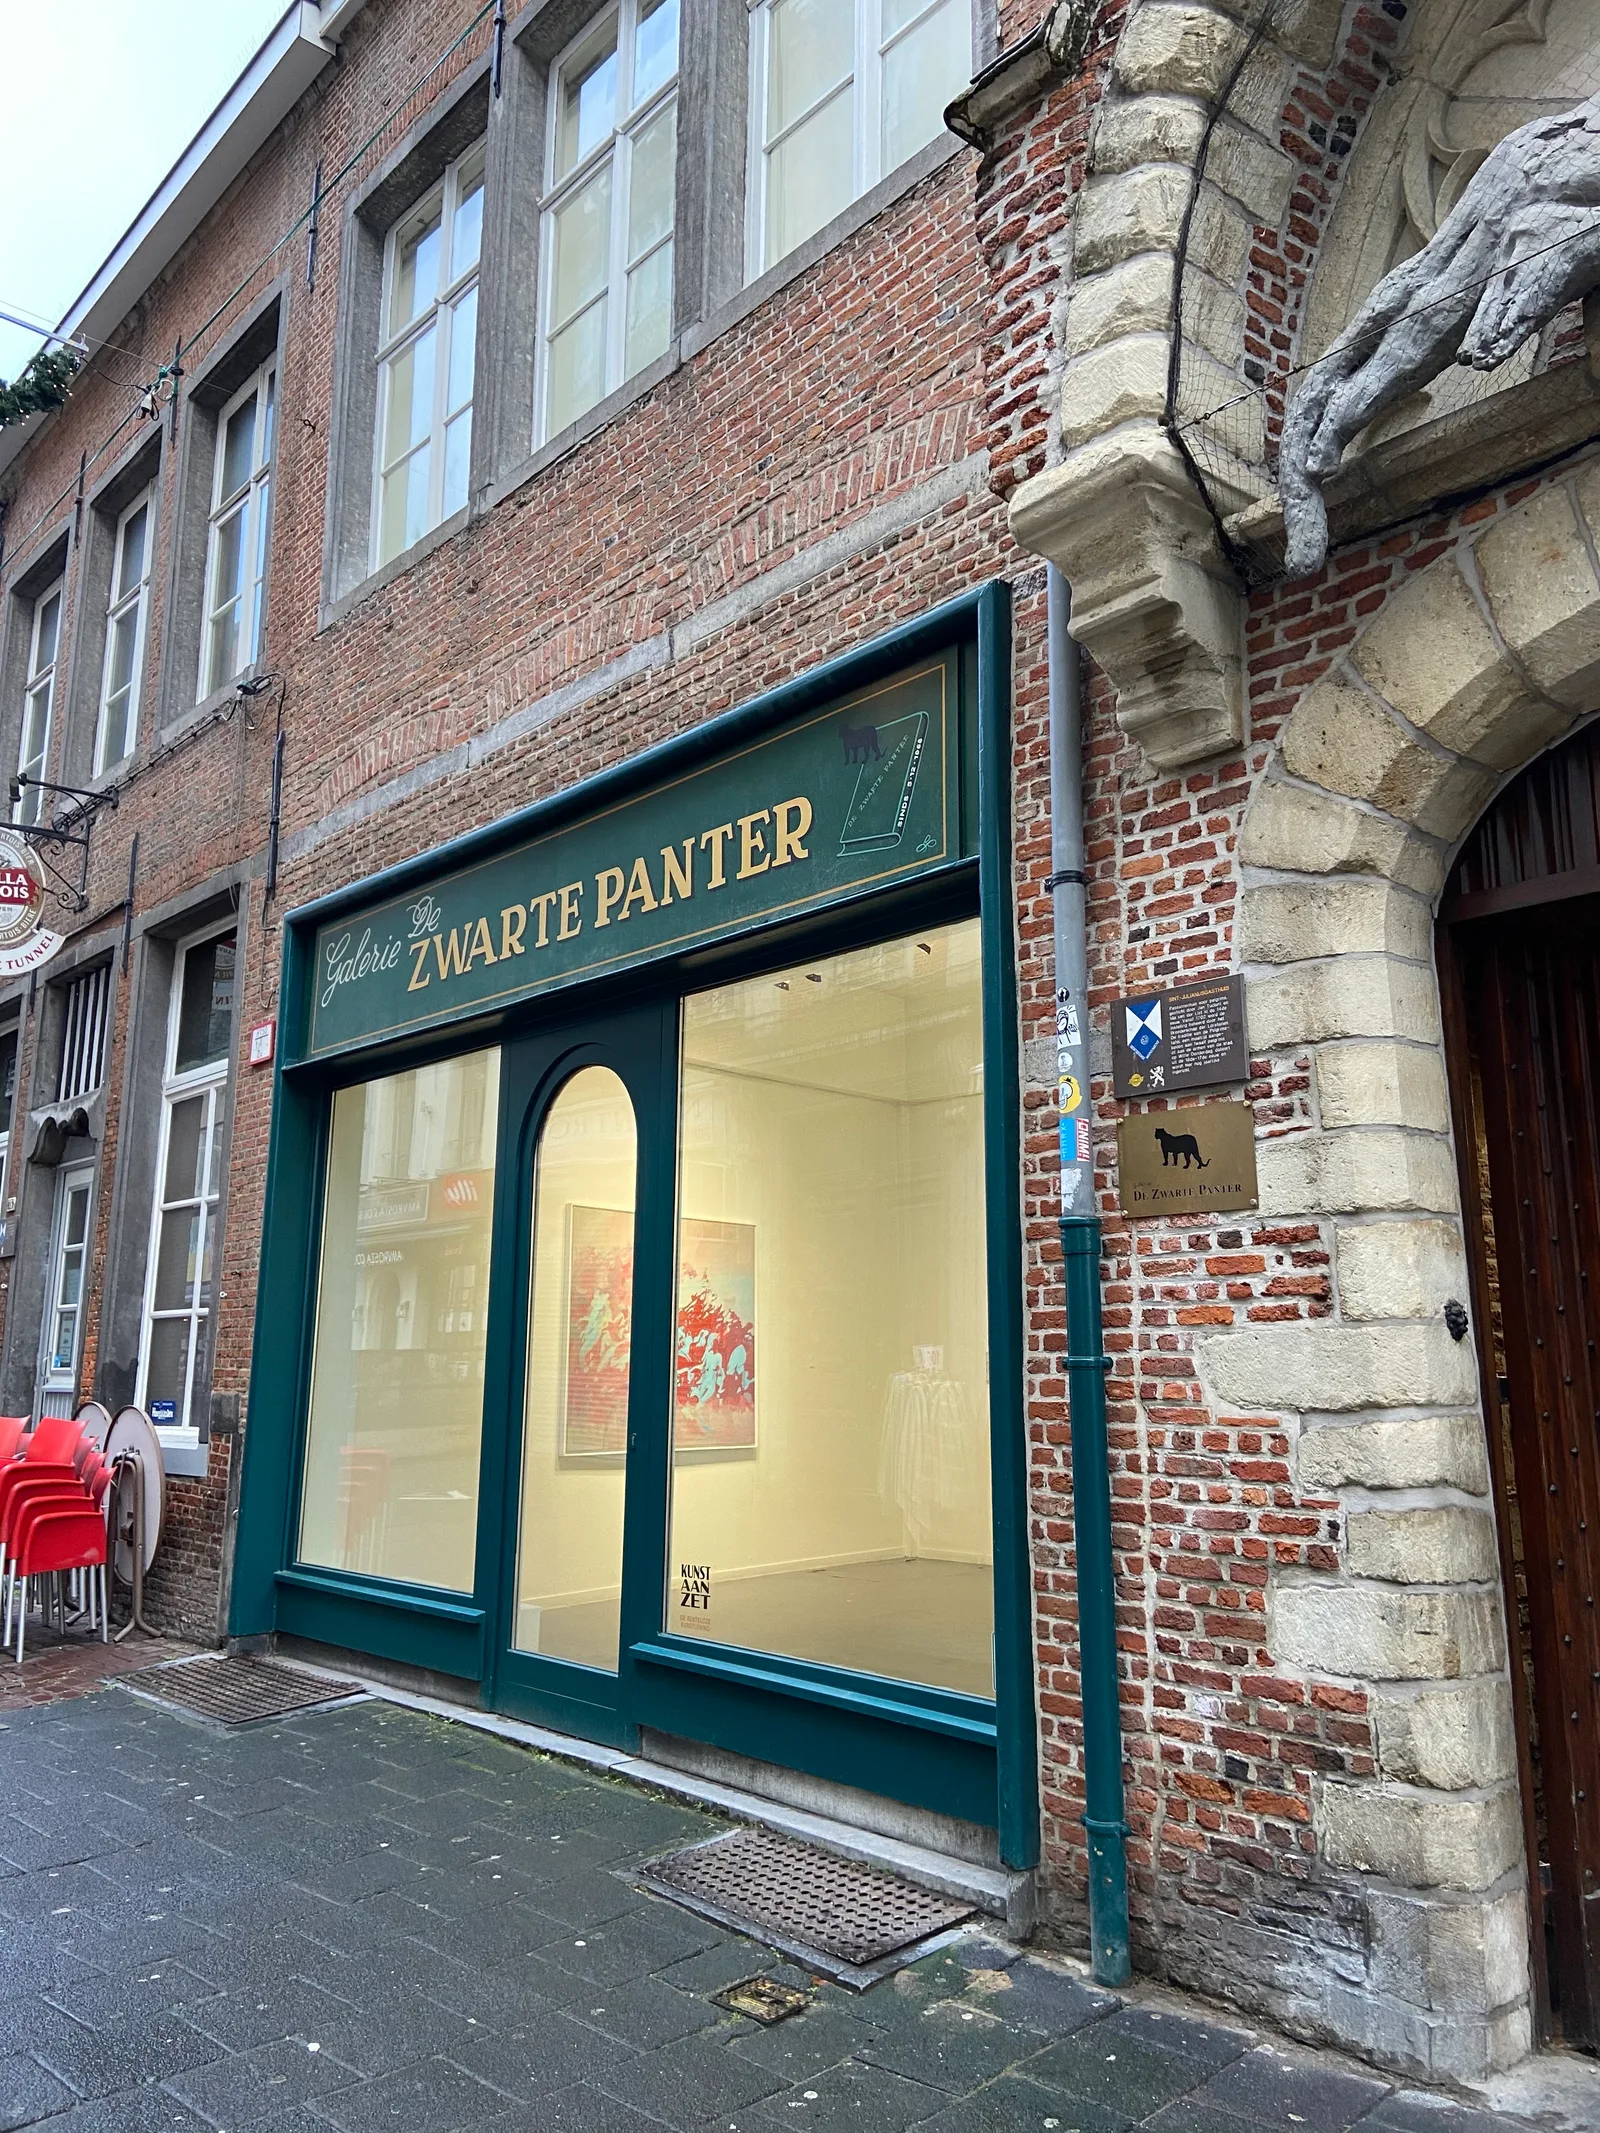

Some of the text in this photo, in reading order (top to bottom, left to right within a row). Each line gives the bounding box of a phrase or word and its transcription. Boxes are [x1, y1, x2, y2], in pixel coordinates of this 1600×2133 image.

[407, 796, 813, 992] ZWARTE PANTER
[406, 895, 442, 938] De
[6, 934, 55, 970] TUNNEL
[321, 928, 401, 1007] Galerie
[681, 1563, 711, 1580] KUNST
[681, 1579, 710, 1594] AAN
[680, 1591, 711, 1610] ZET
